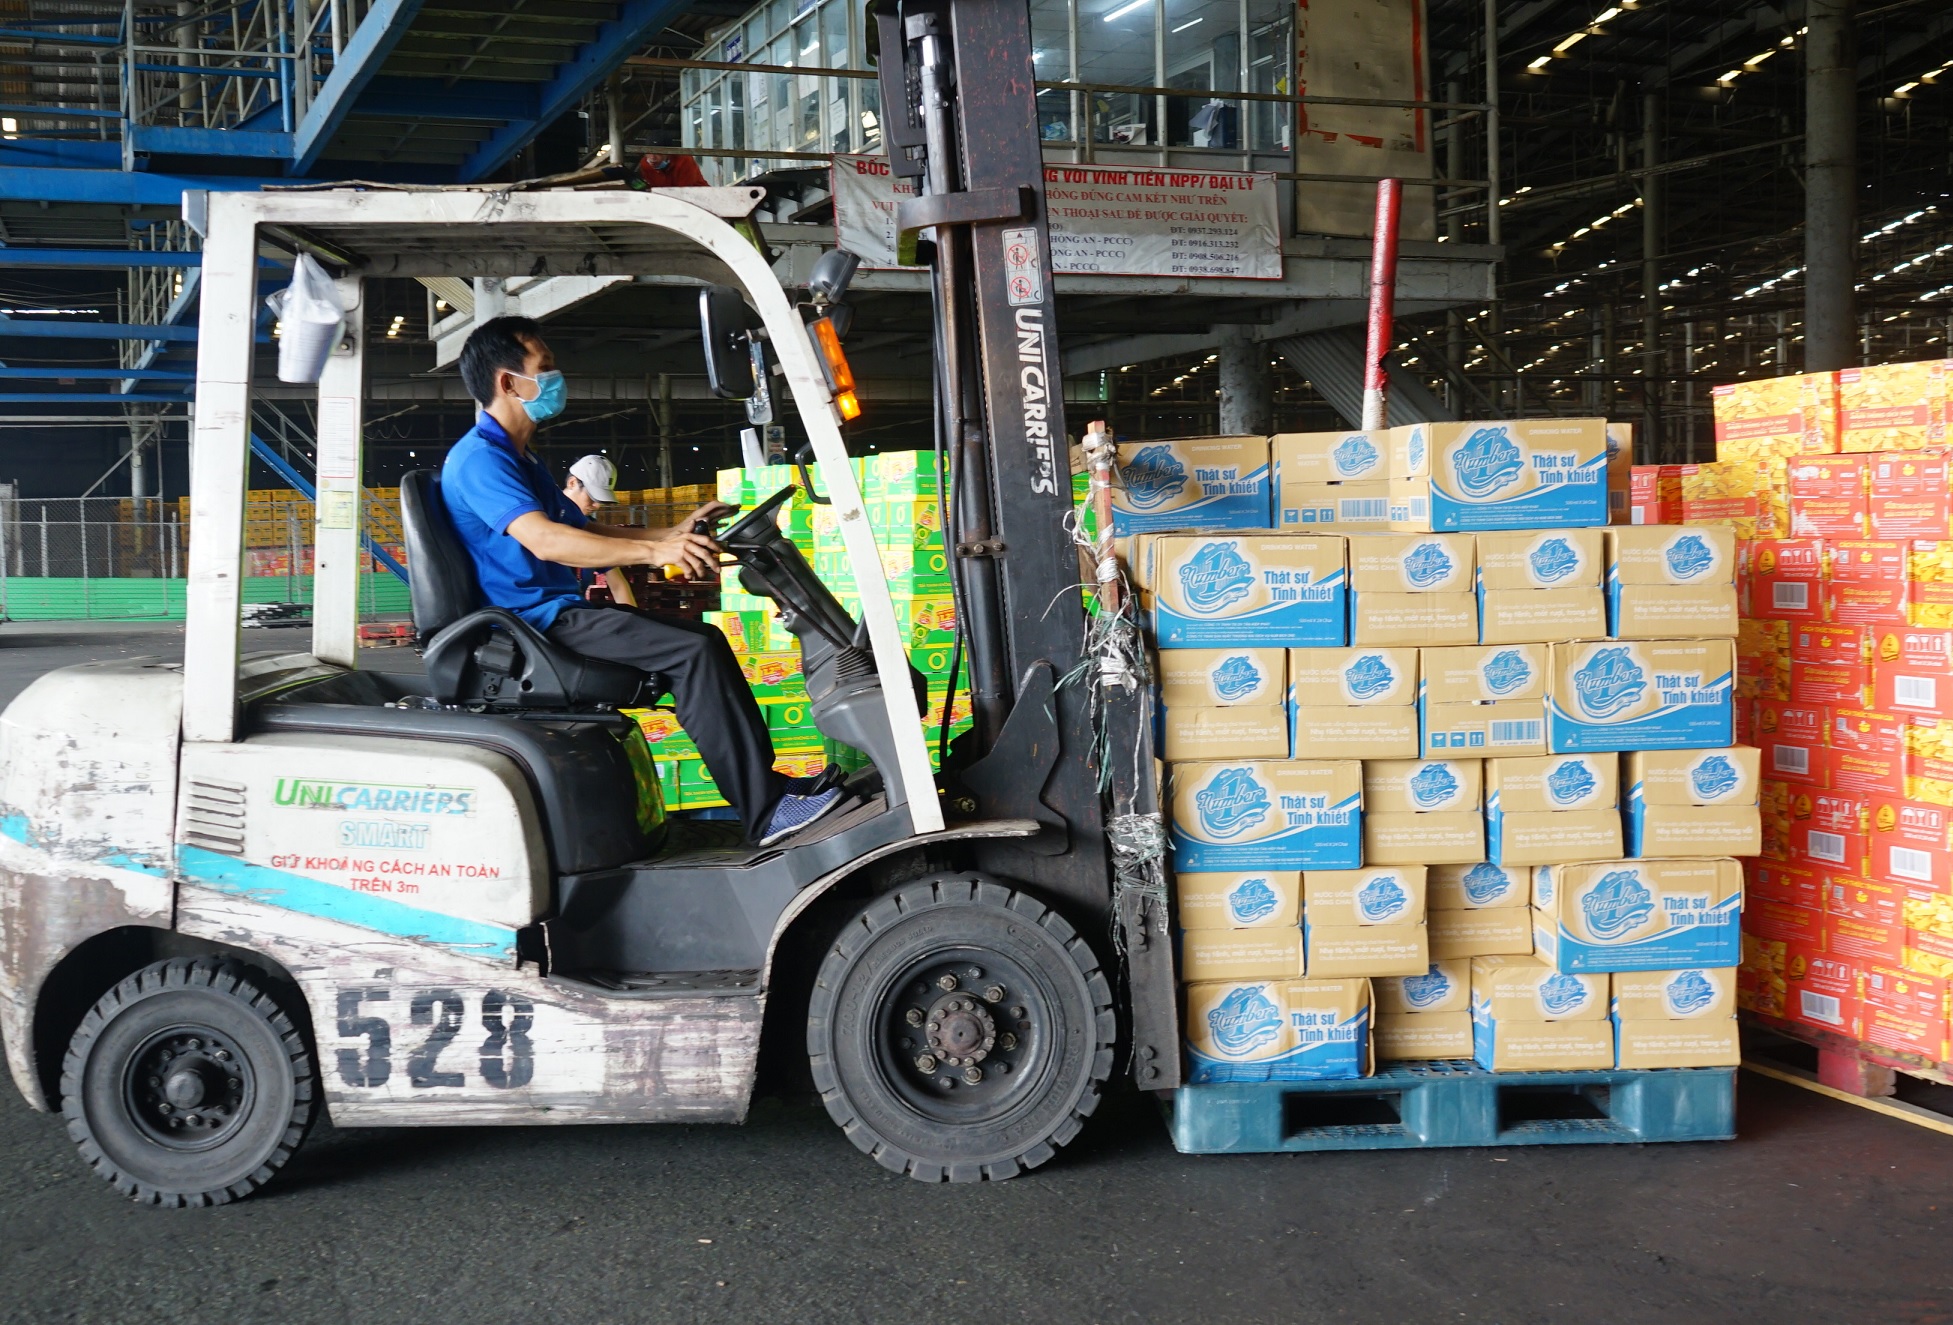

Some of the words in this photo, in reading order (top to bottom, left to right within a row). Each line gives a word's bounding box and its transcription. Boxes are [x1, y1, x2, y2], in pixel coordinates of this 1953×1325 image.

[856, 157, 890, 176] BỐC
[1210, 175, 1234, 192] ĐẠI
[1238, 174, 1254, 190] LÝ
[1045, 187, 1079, 200] HÔNG
[1116, 192, 1143, 203] CAM
[1197, 194, 1228, 206] TRÊN
[872, 200, 894, 212] VUI
[1063, 207, 1099, 220] THOẠI
[1101, 209, 1125, 220] SAU
[1080, 236, 1096, 244] AN
[1566, 467, 1598, 484] khiết
[1228, 479, 1259, 495] khiết
[1300, 585, 1333, 601] khiết
[1690, 688, 1722, 704] khiết
[1315, 809, 1349, 825] khiết
[339, 820, 429, 850] SMART
[379, 858, 424, 876] CÁCH
[428, 864, 451, 877] AN
[457, 863, 500, 879] TOÀN
[350, 876, 392, 893] TRÊN
[397, 880, 419, 894] 3m
[1698, 909, 1730, 925] khiết
[335, 987, 535, 1089] 528
[1327, 1026, 1359, 1042] khiết
